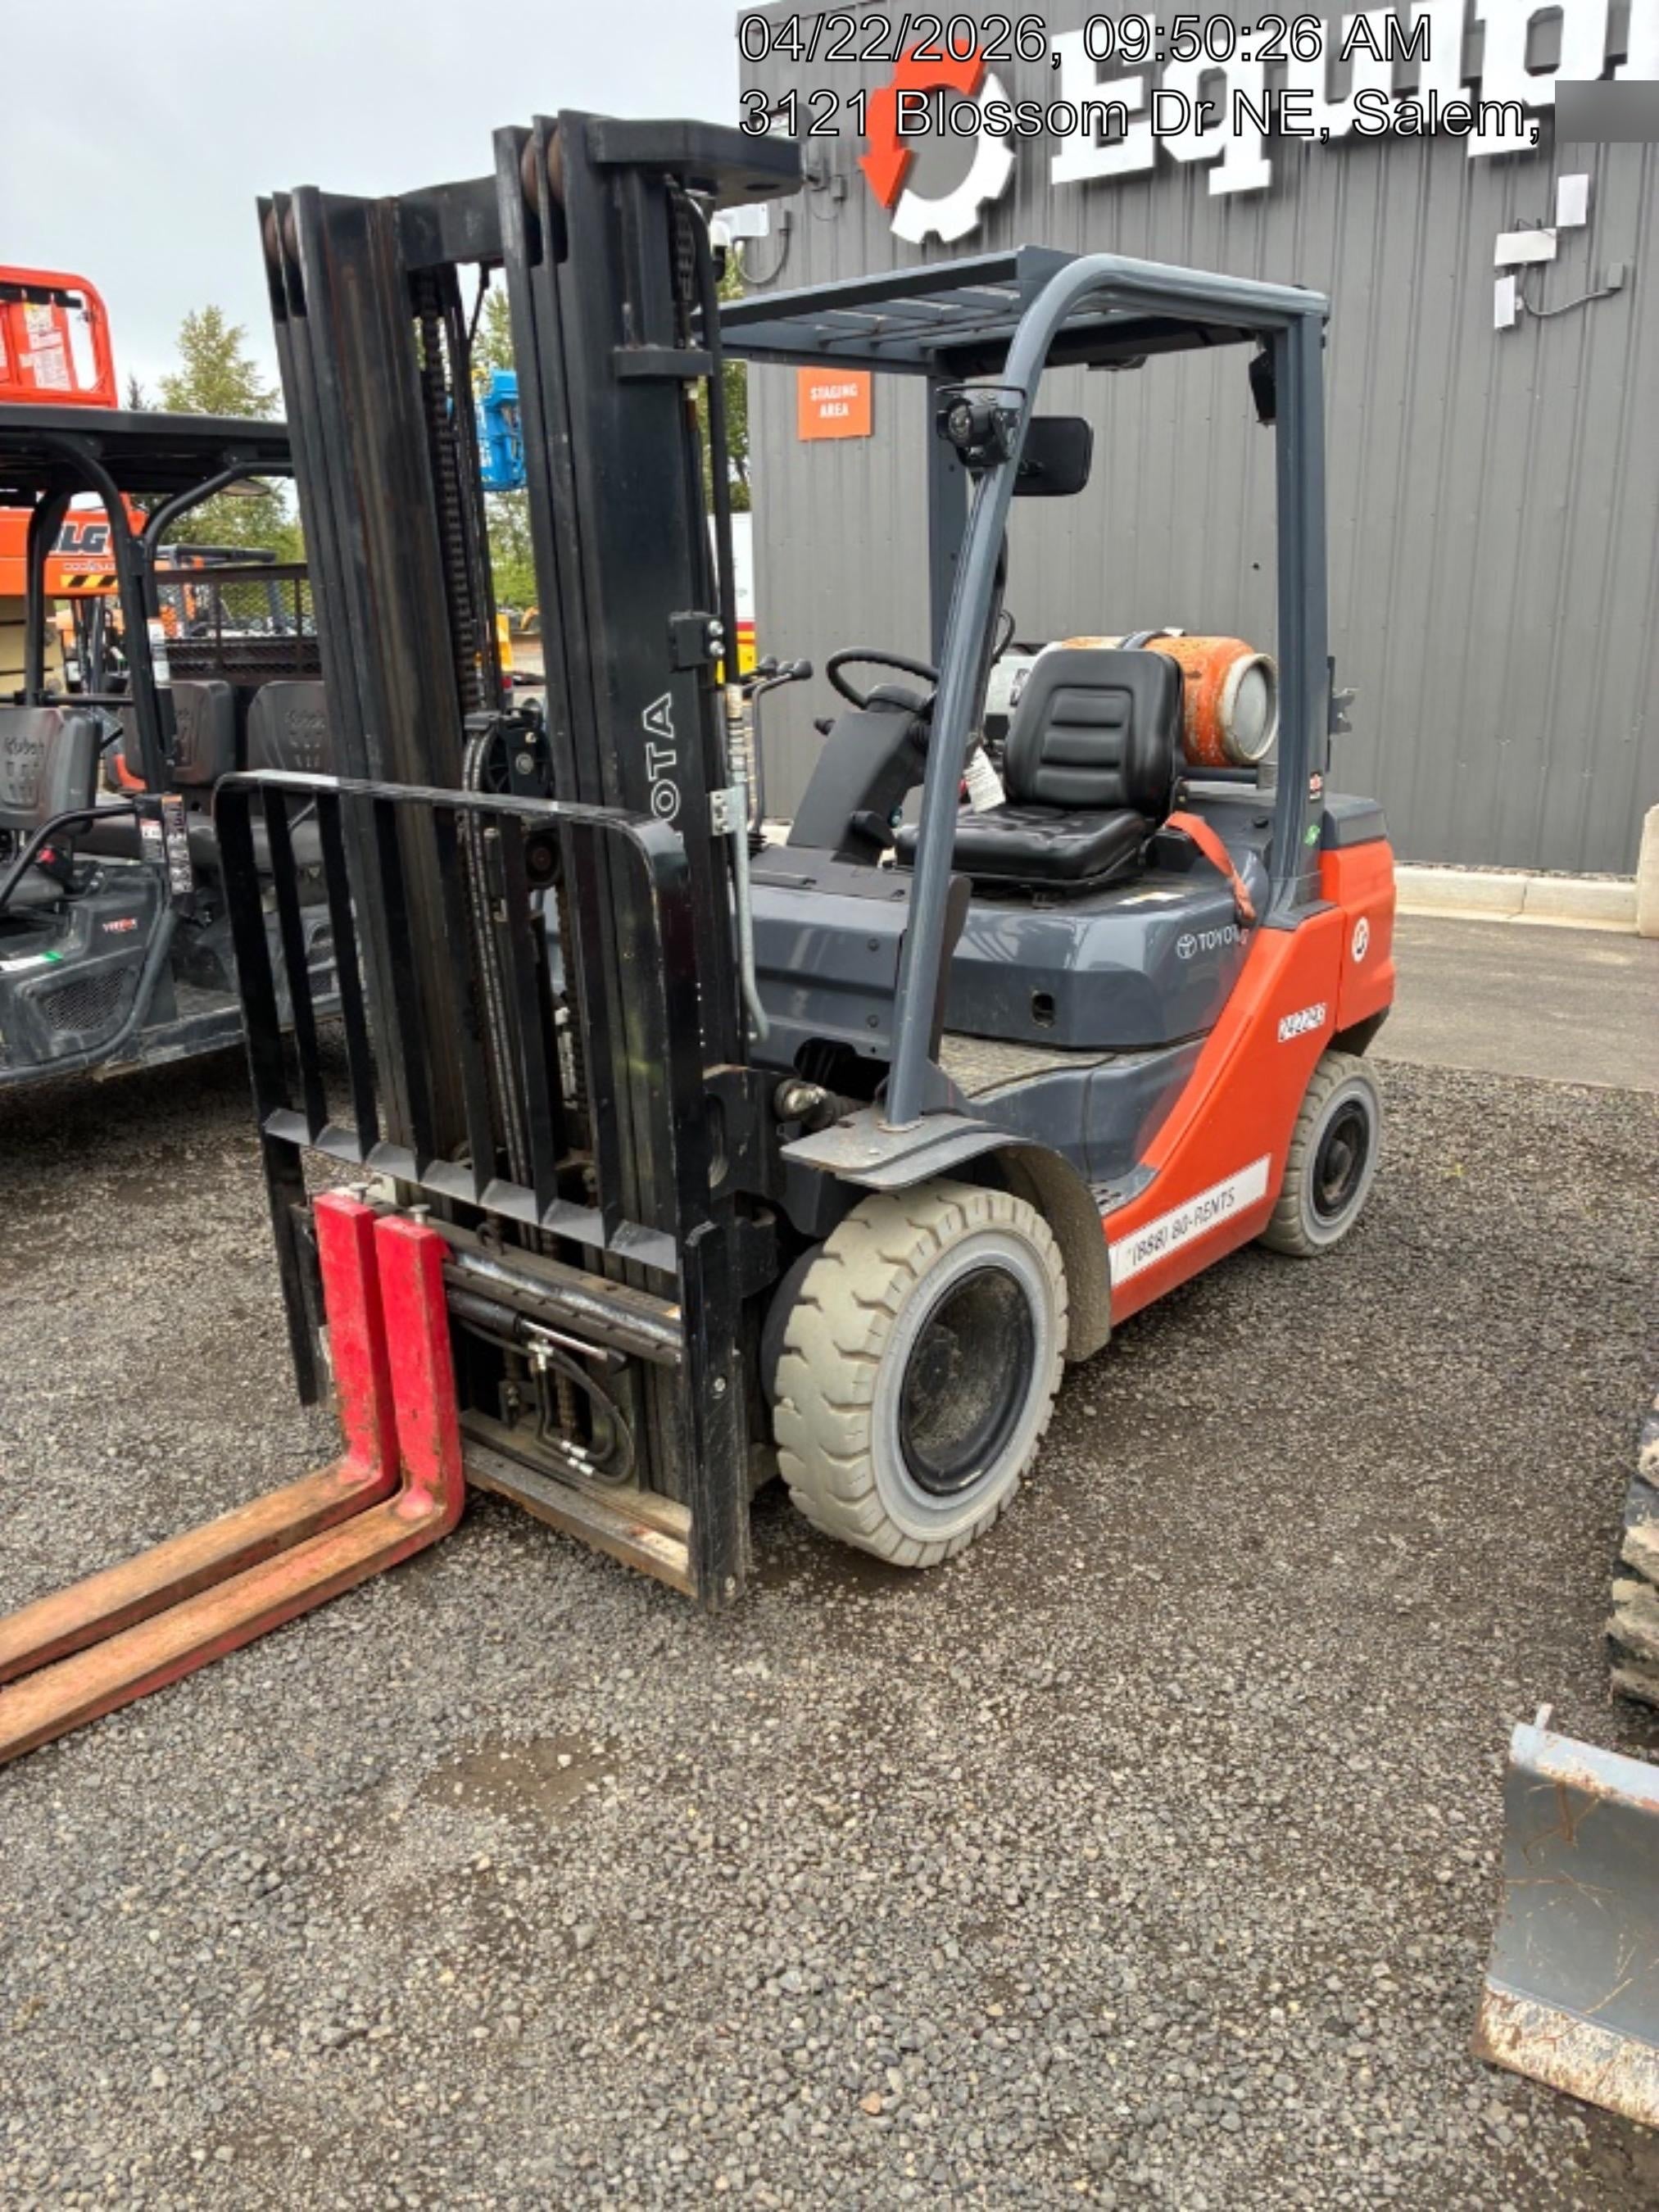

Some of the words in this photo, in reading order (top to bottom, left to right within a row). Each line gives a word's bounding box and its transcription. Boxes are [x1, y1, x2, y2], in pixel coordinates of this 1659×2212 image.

[1051, 0, 1659, 196] Equip
[809, 383, 859, 402] STAGING
[819, 402, 850, 419] AREA
[52, 522, 111, 556] LG
[641, 691, 684, 837] OTA
